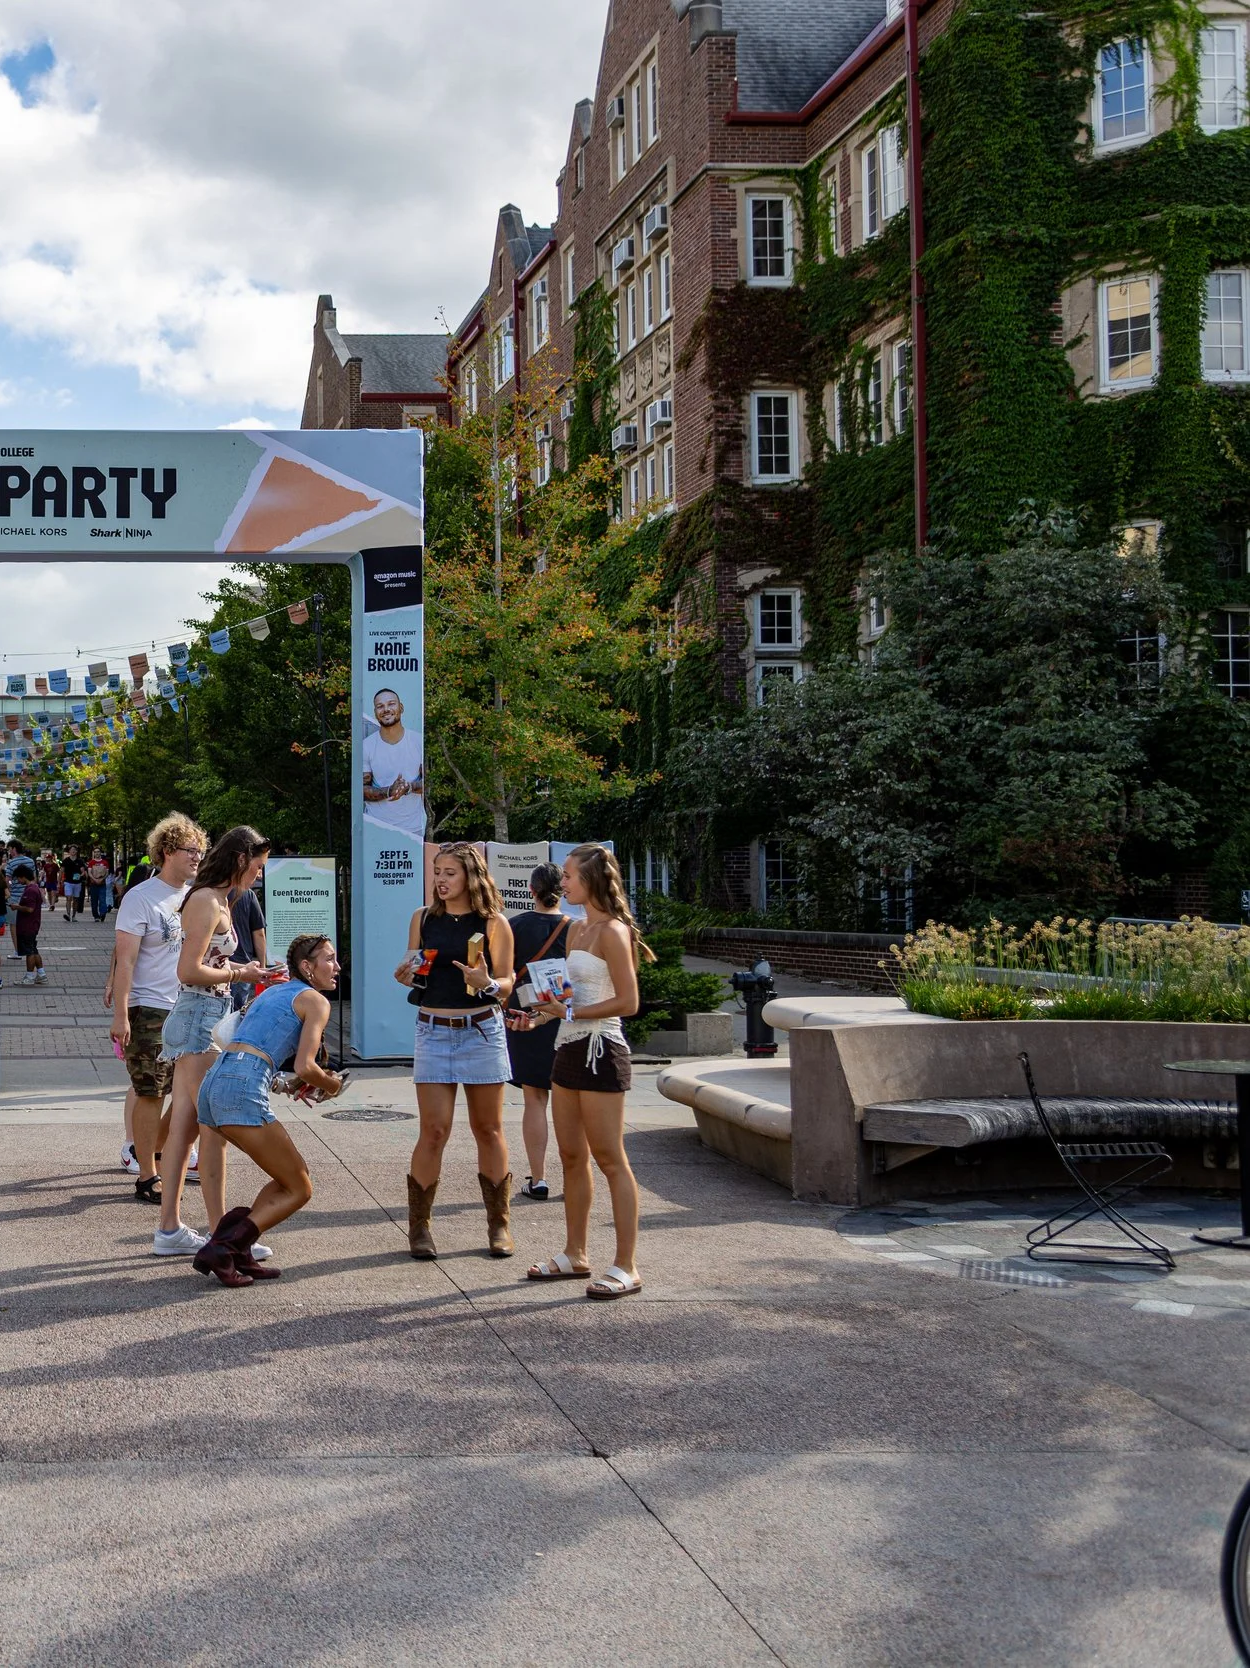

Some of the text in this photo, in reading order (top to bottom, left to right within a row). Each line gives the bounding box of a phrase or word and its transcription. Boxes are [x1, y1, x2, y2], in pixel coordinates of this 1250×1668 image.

[40, 528, 67, 536] KORS
[90, 528, 121, 538] Shark
[374, 572, 397, 582] amazon
[375, 642, 410, 655] KANE
[368, 658, 418, 672] BROWN
[380, 851, 408, 859] SEPT 5
[376, 861, 412, 869] 7:30 PM
[508, 879, 528, 887] FIRST
